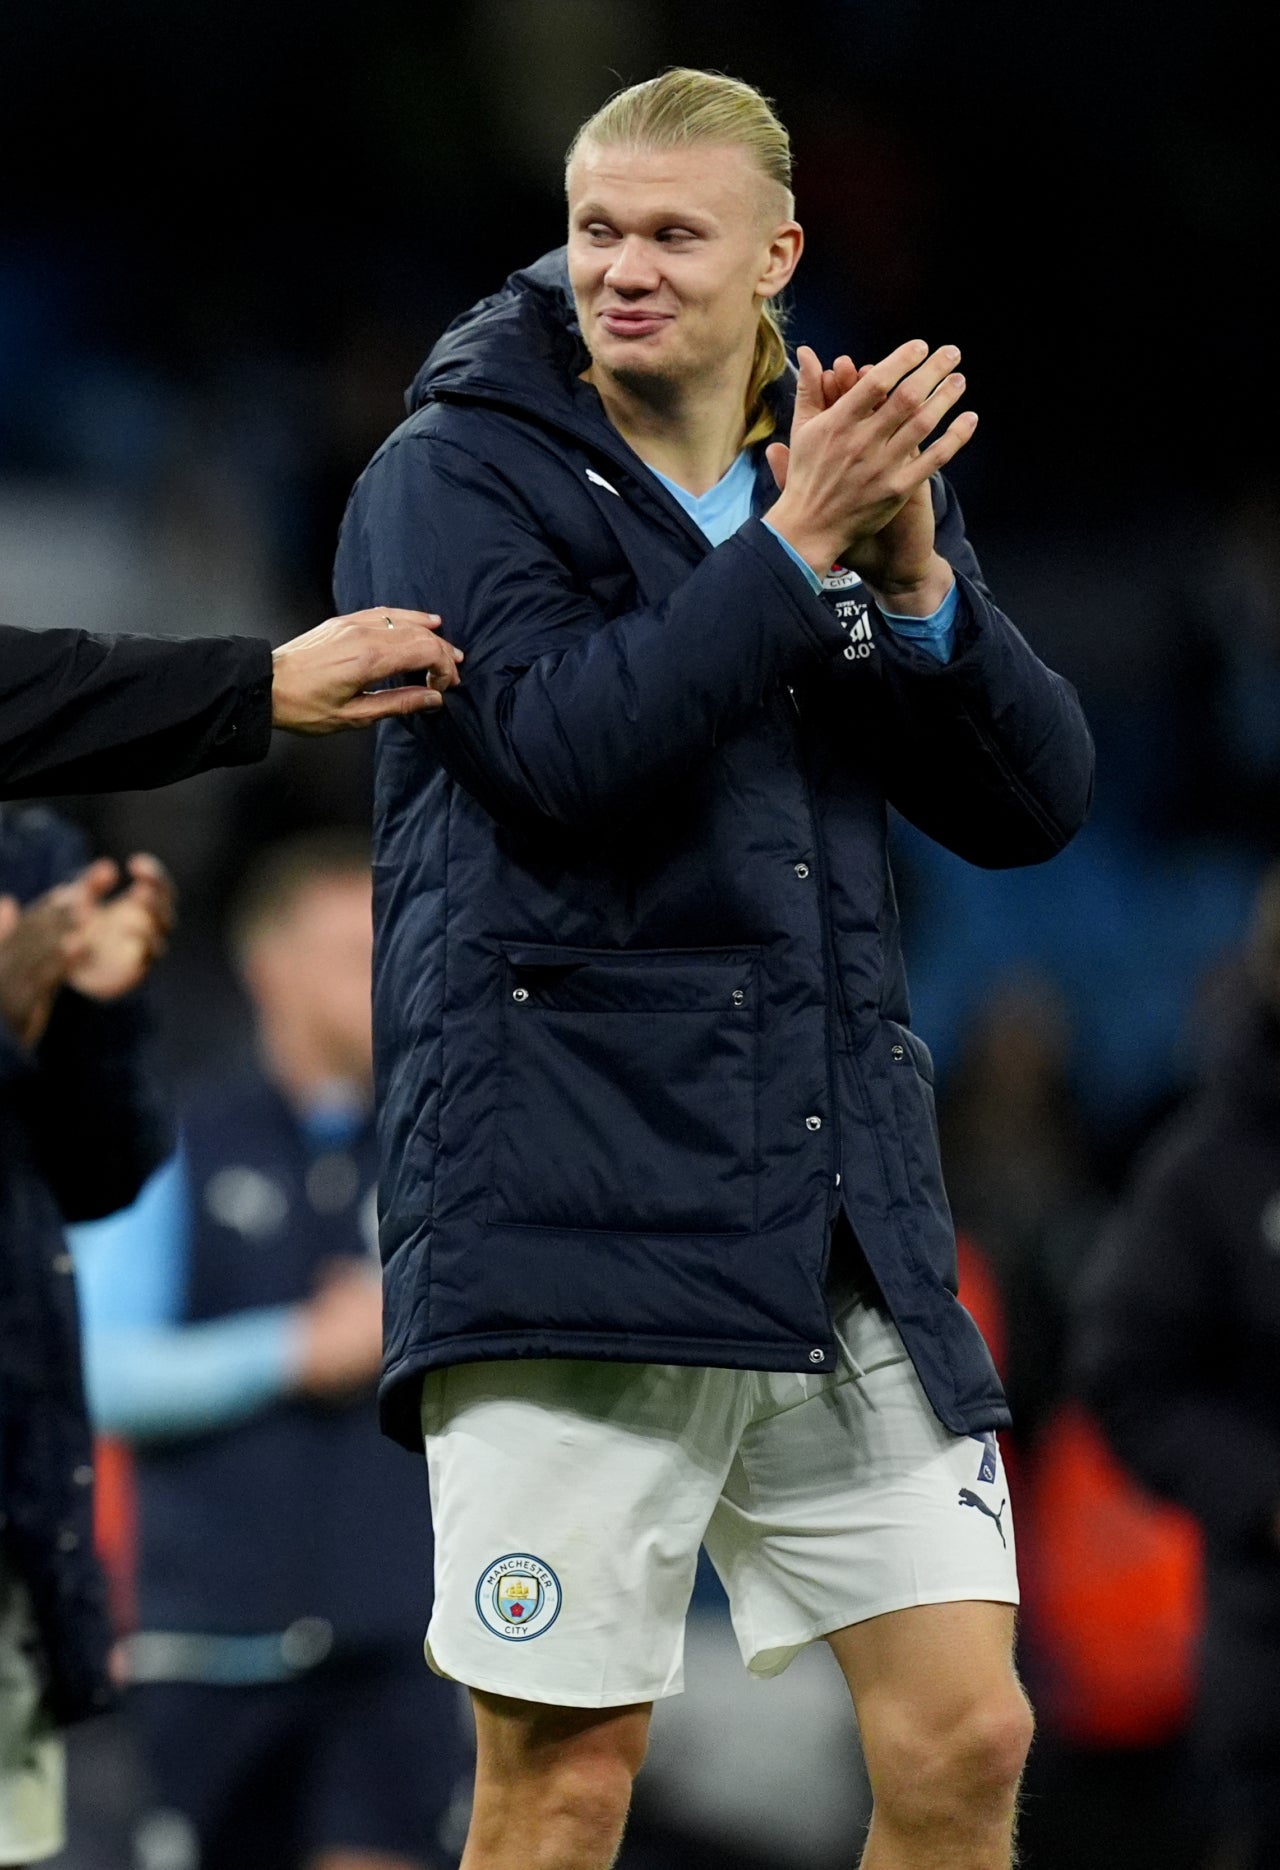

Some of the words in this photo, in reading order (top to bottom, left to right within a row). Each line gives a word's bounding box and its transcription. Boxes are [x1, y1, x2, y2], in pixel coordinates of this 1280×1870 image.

[830, 577, 853, 588] CITY
[487, 1560, 553, 1588] MANCHESTER
[504, 1626, 528, 1635] CITY
